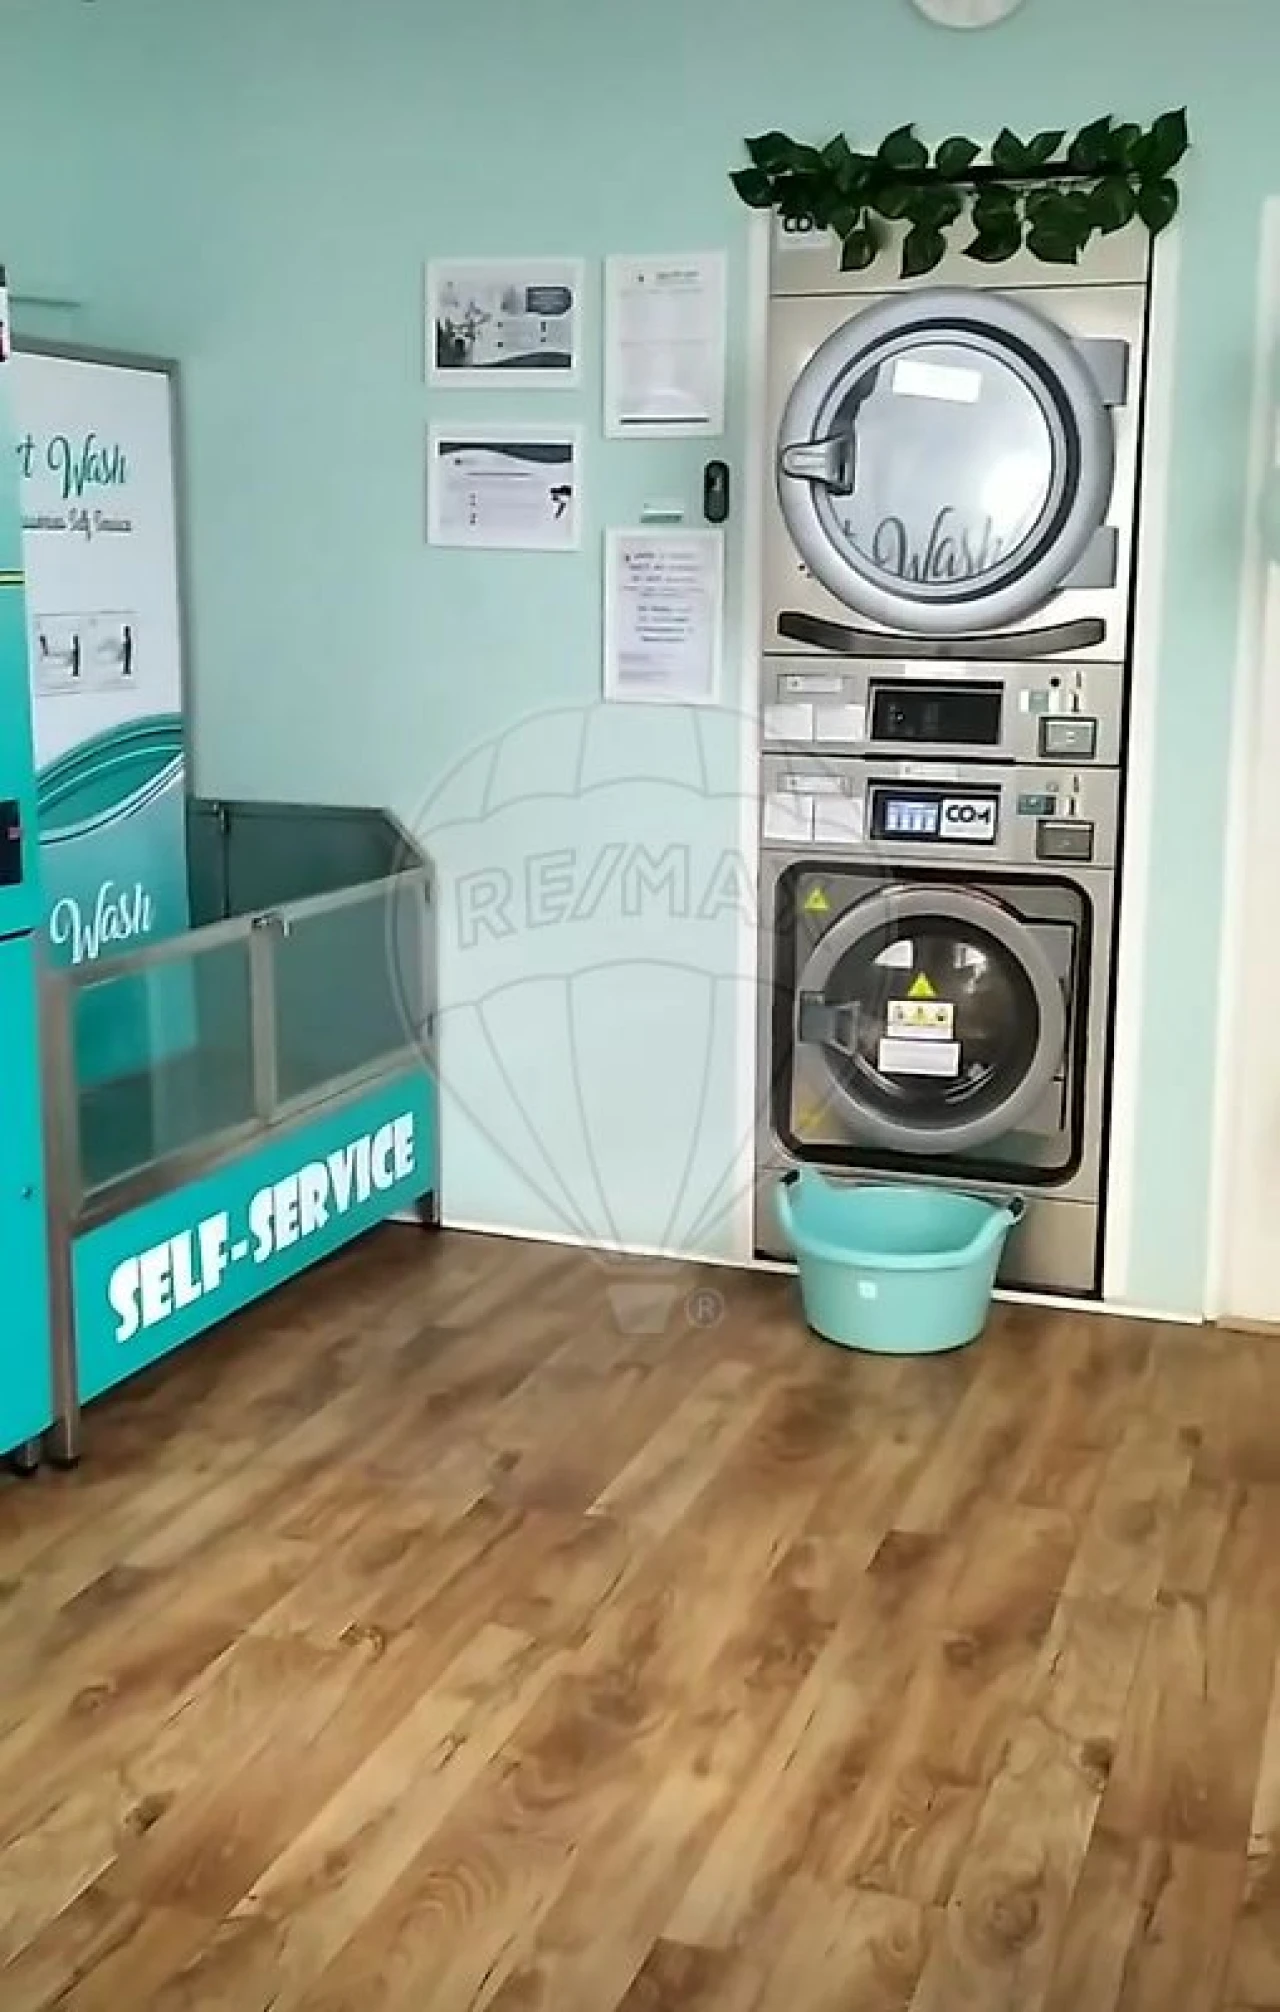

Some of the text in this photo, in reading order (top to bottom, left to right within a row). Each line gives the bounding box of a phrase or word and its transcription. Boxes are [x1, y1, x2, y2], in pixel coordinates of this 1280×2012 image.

[48, 433, 126, 498] Wash
[51, 880, 151, 963] Wash
[108, 1112, 415, 1343] SELF-SERVICE
